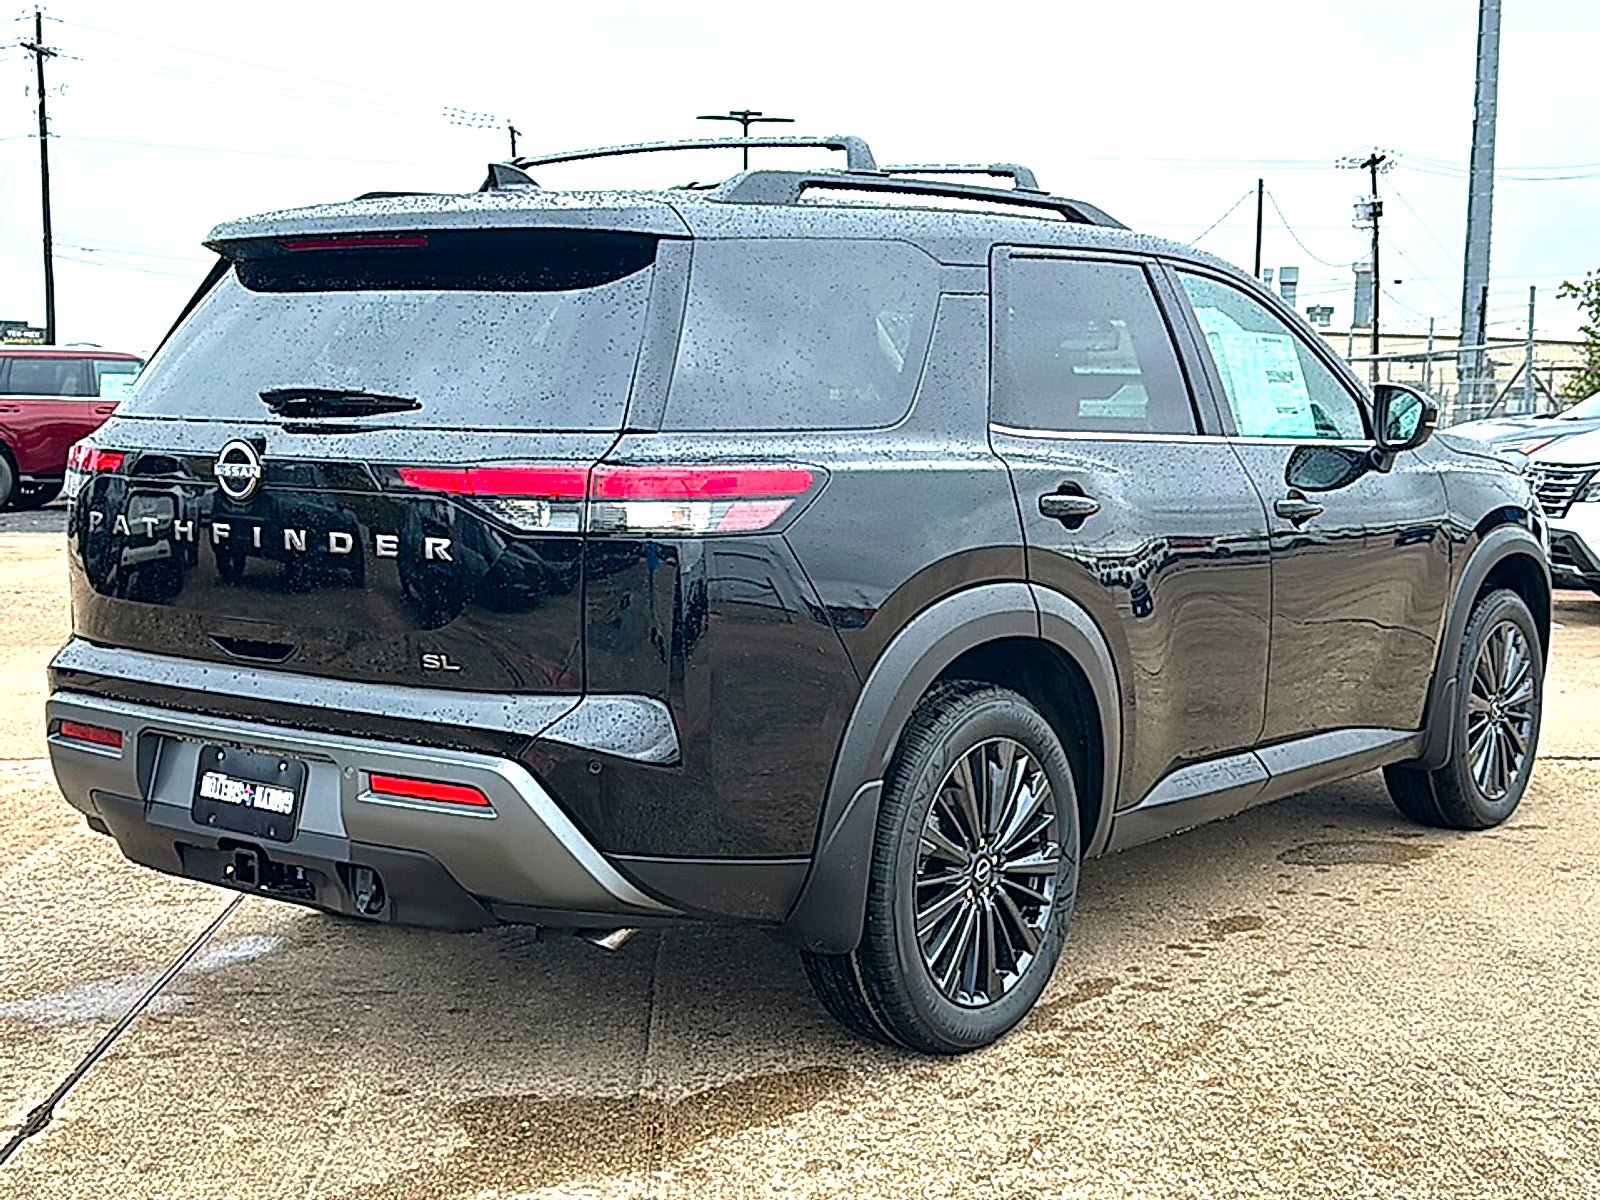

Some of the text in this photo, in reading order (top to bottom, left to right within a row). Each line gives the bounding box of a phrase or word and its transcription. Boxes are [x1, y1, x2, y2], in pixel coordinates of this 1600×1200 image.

[214, 463, 261, 479] NISSAN
[88, 511, 453, 562] PATHFINDER
[422, 653, 461, 670] SL
